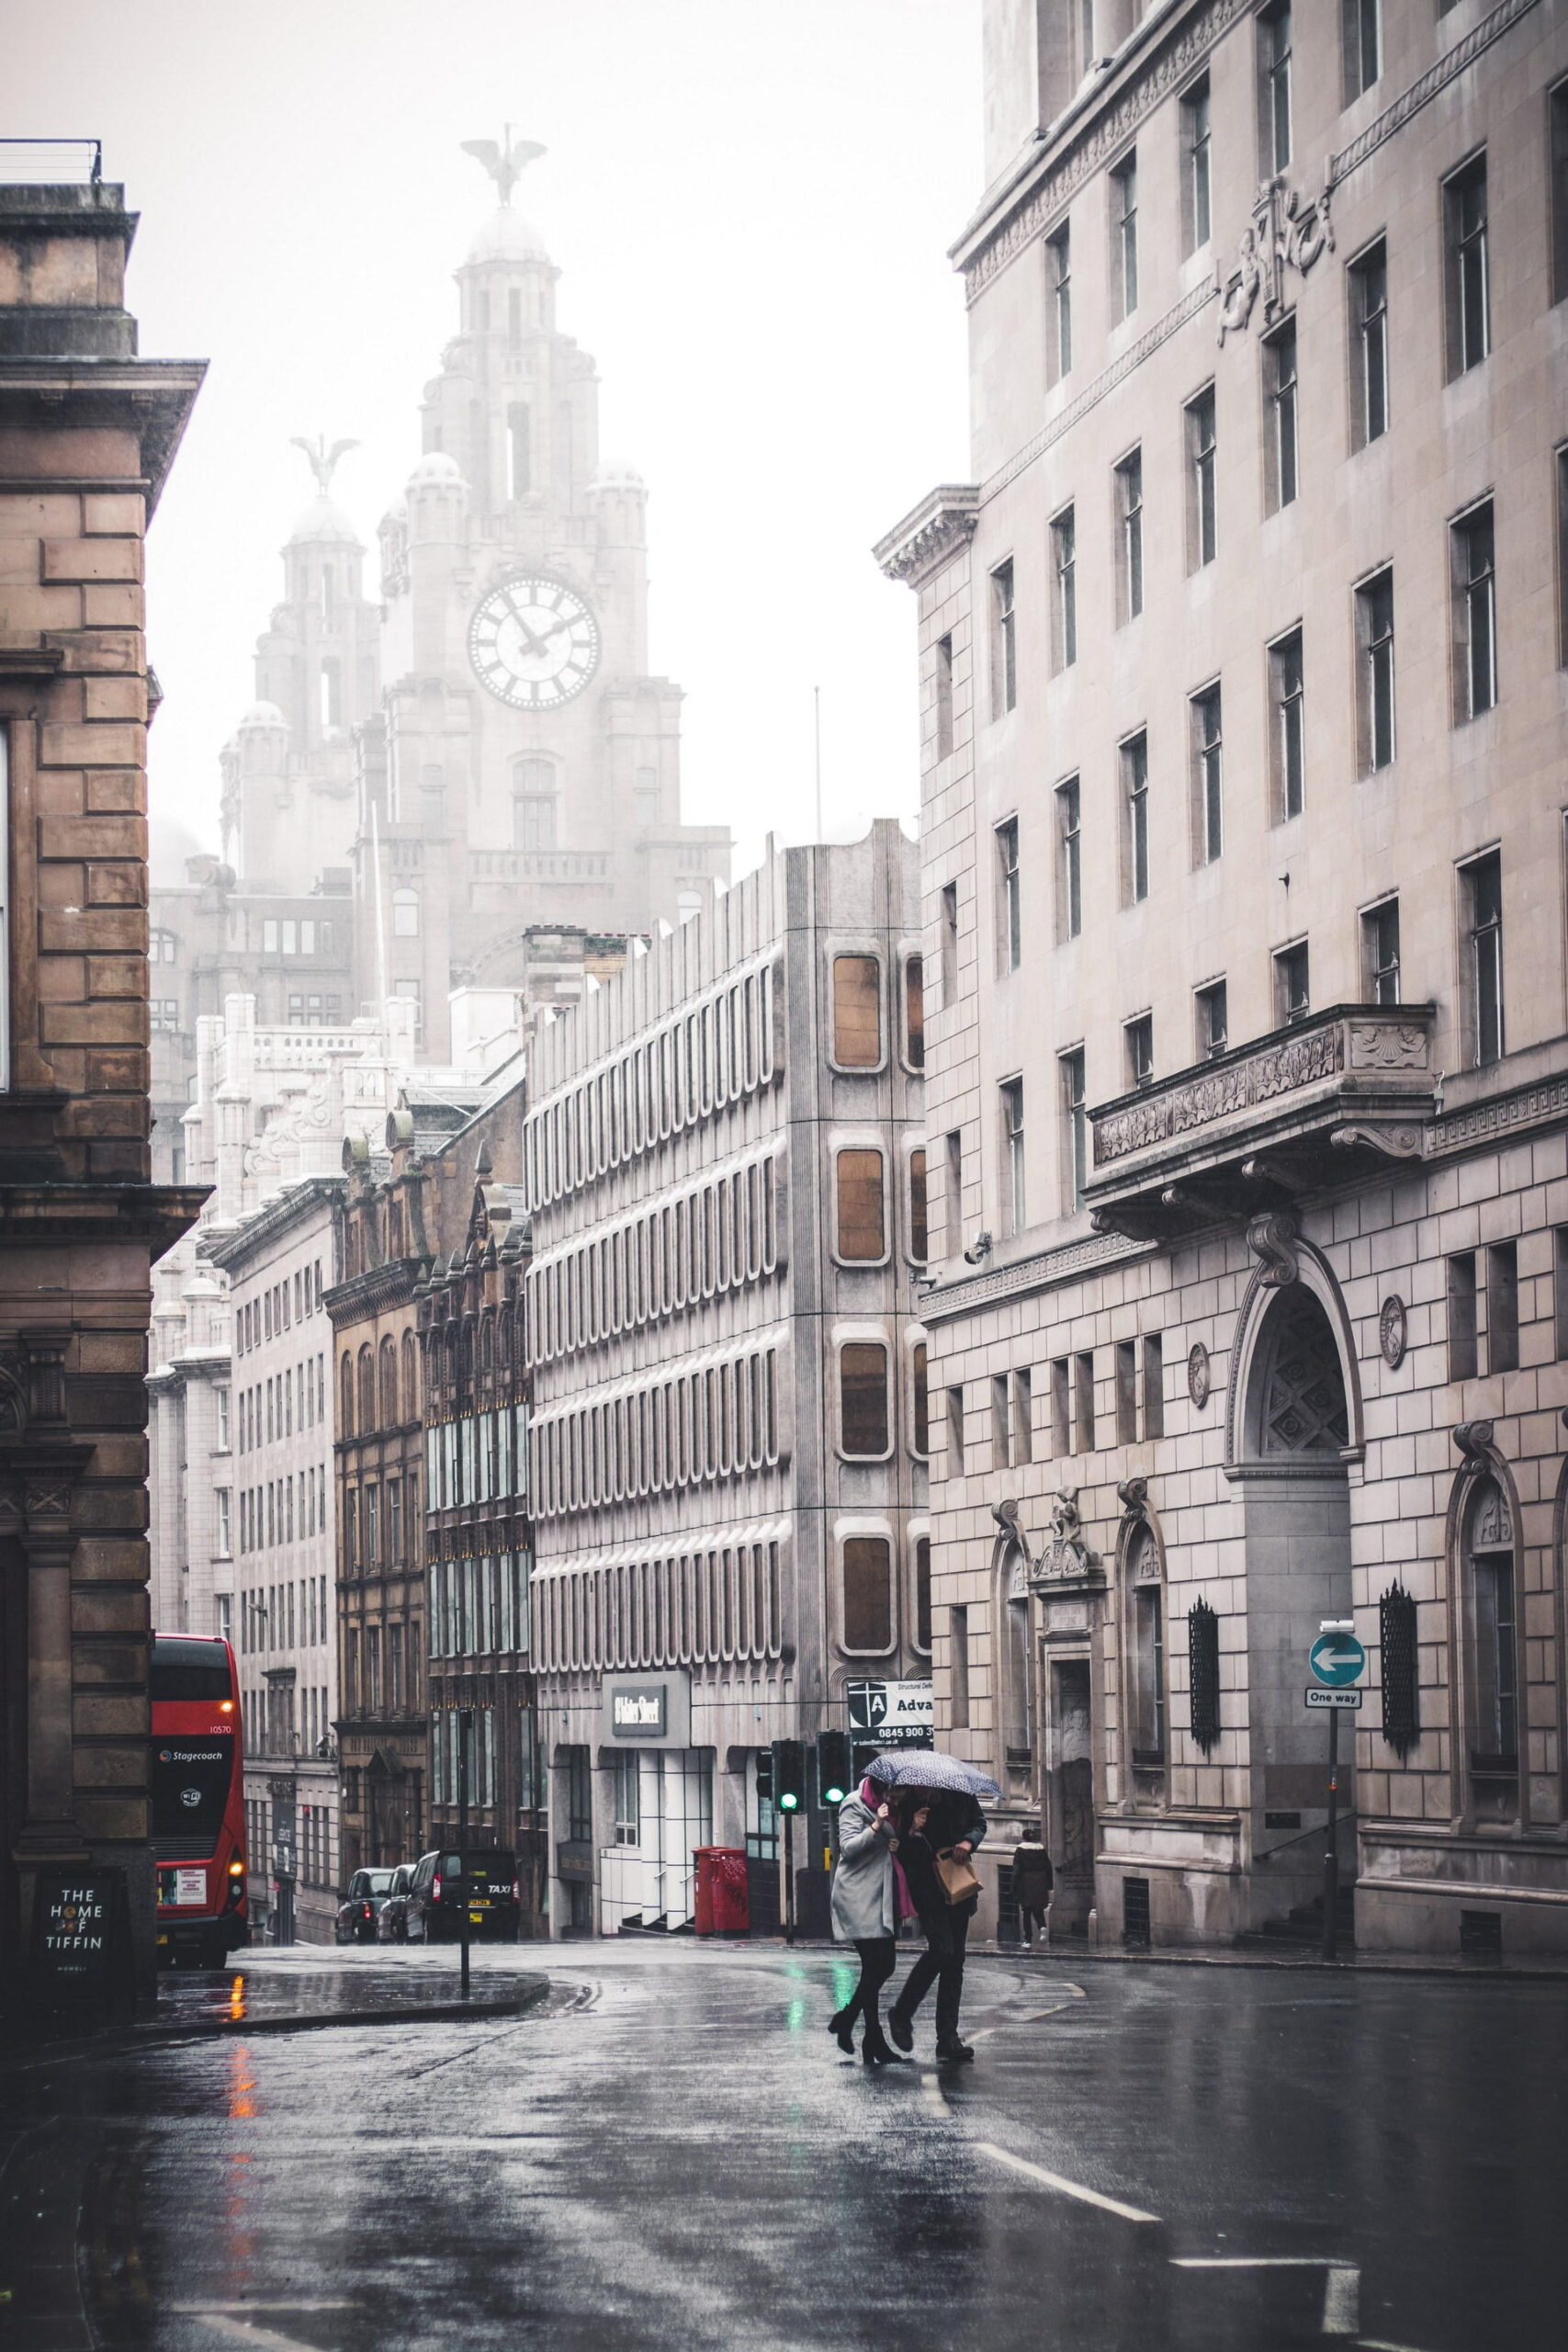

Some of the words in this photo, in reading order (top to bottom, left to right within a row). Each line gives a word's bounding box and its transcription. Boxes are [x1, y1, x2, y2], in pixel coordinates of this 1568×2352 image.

[871, 1695, 886, 1713] A
[1310, 1692, 1332, 1702] One
[1336, 1694, 1357, 1704] way
[897, 1699, 933, 1711] Adva
[209, 1725, 231, 1734] 10570
[878, 1728, 903, 1738] 0845
[905, 1727, 923, 1737] 900
[173, 1751, 222, 1762] Stagecoach
[488, 1884, 511, 1894] TAXI
[62, 1889, 94, 1902] THE
[46, 1937, 102, 1949] TIFFIN
